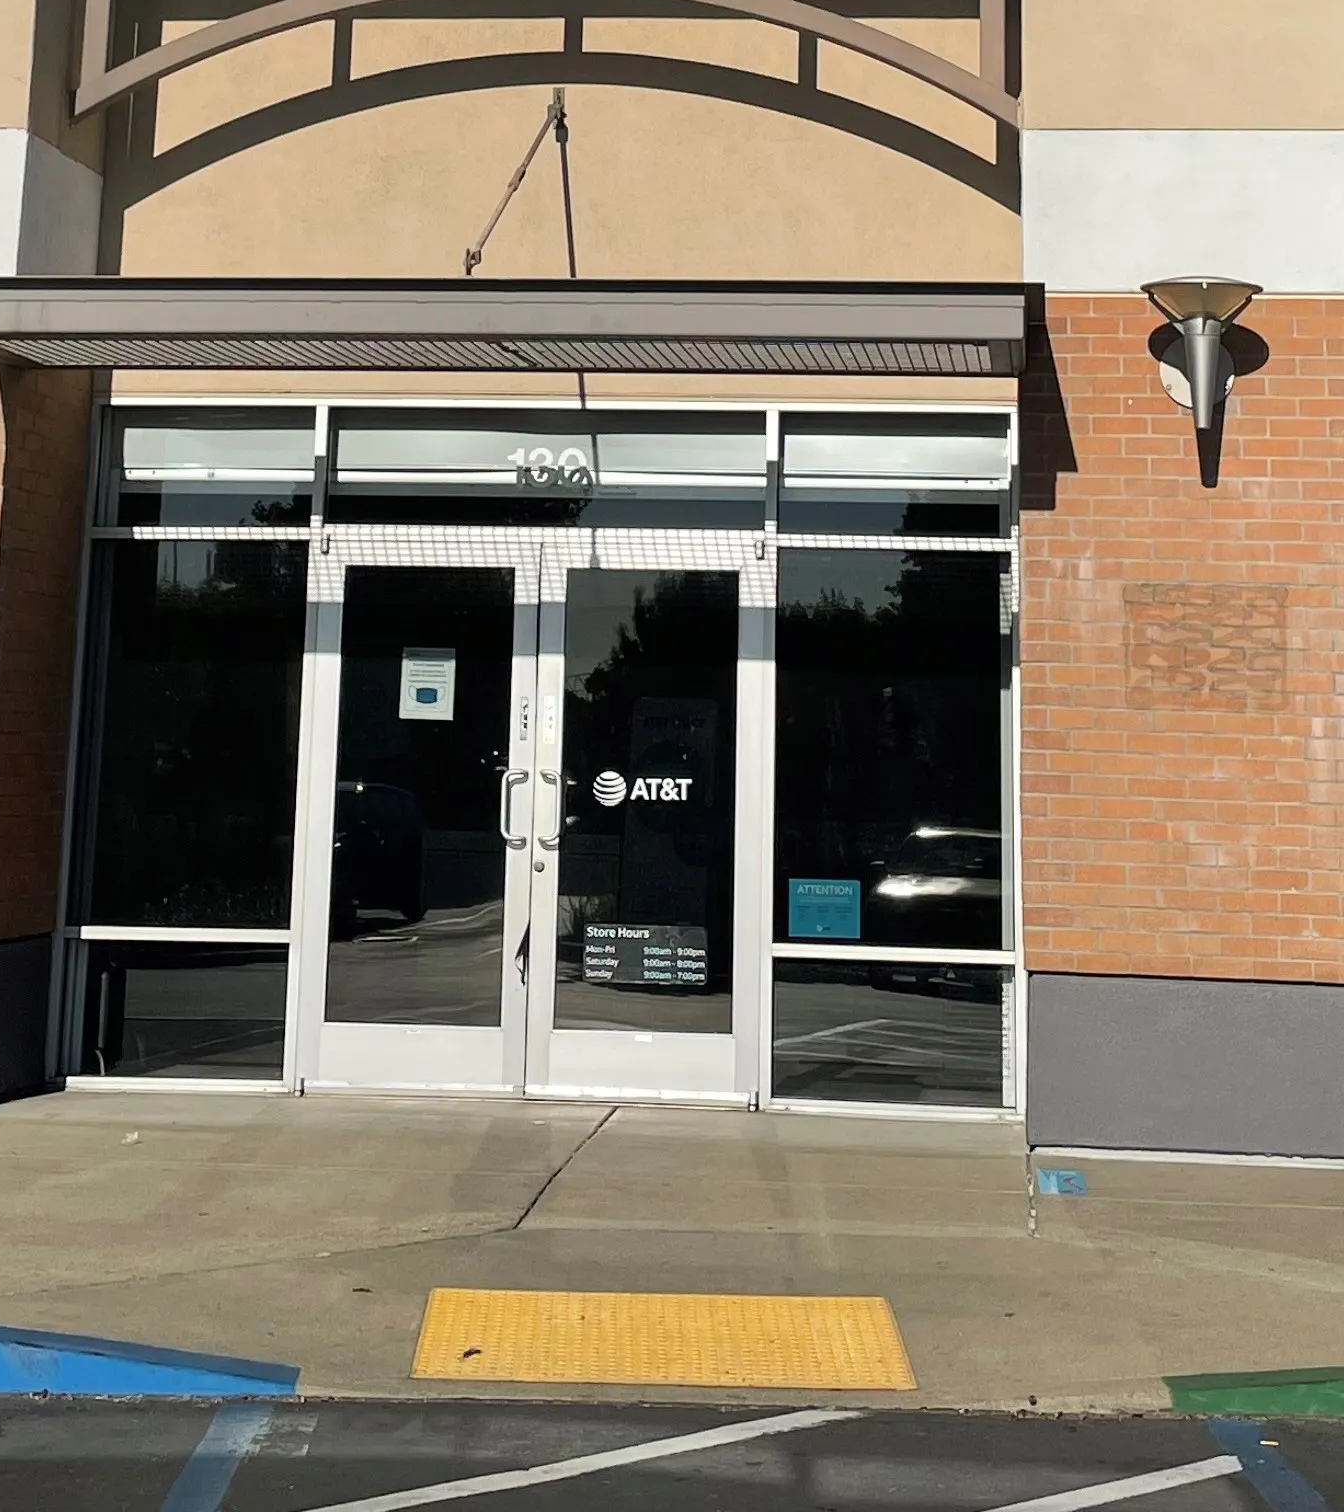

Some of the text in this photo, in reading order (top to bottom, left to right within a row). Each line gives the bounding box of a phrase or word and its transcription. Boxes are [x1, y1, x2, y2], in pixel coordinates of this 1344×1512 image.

[630, 778, 693, 801] AT&T
[797, 884, 853, 896] ATTENTION
[586, 926, 650, 939] Store Hours
[585, 957, 620, 968] Saturday
[585, 969, 613, 980] Sunday
